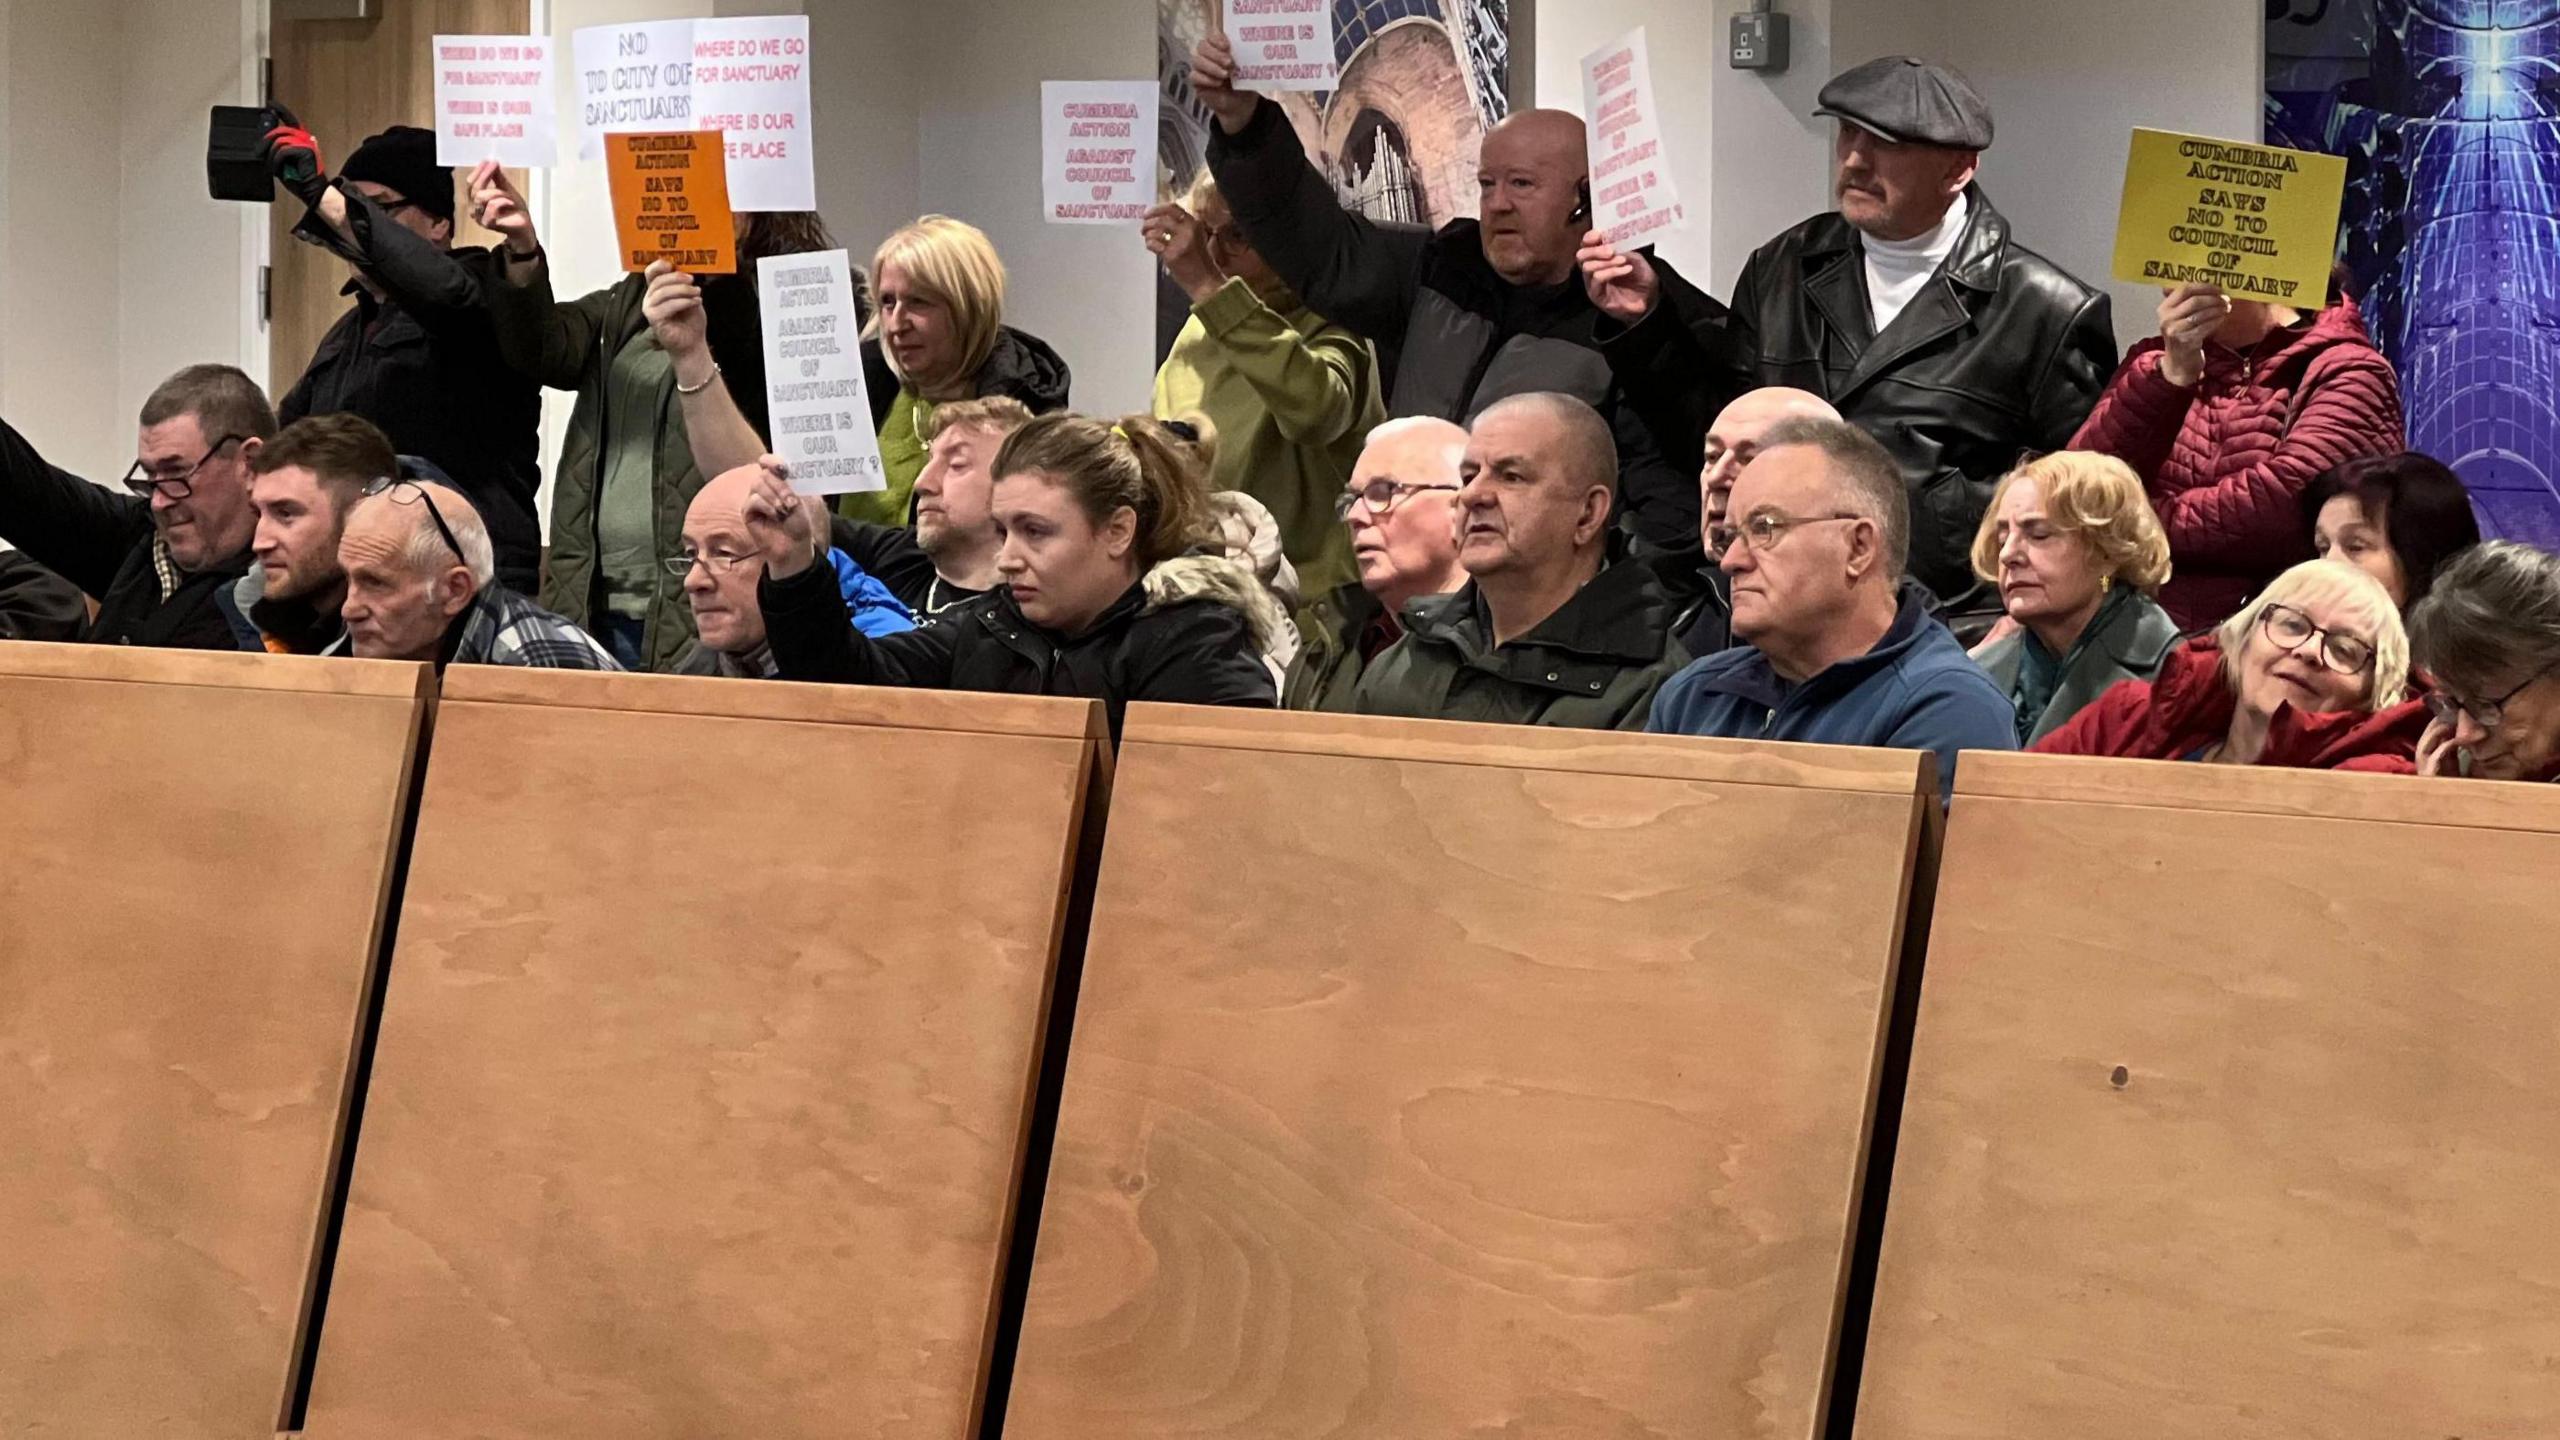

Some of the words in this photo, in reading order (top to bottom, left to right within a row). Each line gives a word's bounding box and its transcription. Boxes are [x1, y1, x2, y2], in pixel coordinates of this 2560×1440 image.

[1298, 24, 1314, 40] IS
[619, 32, 647, 56] NO
[695, 41, 735, 57] WHERE
[738, 40, 756, 56] DO
[760, 39, 780, 56] WE
[784, 38, 805, 55] GO
[1263, 44, 1298, 60] OUR
[585, 69, 607, 94] TO
[612, 64, 657, 91] CITY
[664, 62, 692, 86] OF
[696, 66, 718, 83] FOR
[722, 64, 800, 82] SANCTUARY
[1063, 103, 1138, 119] CUMBRIA
[701, 114, 743, 130] WHERE
[747, 113, 759, 130] IS
[763, 113, 794, 130] OUR
[1069, 122, 1131, 137] ACTION
[741, 141, 786, 158] PLACE
[1066, 148, 1136, 164] AGAINST
[2179, 140, 2298, 173] CUMBRIA
[635, 154, 690, 170] ACTION
[1065, 167, 1136, 182] COUNCIL
[2187, 161, 2283, 190] ACTION
[645, 177, 684, 192] SAYS
[1091, 186, 1112, 201] OF
[641, 197, 662, 212] NO
[667, 196, 689, 212] TO
[2200, 188, 2266, 212] SAYS
[636, 215, 700, 231] COUNCIL
[2187, 207, 2224, 228] NO
[2235, 214, 2268, 234] TO
[659, 233, 678, 249] OF
[2169, 225, 2278, 257] COUNCIL
[2208, 251, 2241, 270] OF
[2144, 260, 2298, 298] SANCTUARY
[780, 287, 829, 308] ACTION
[778, 315, 837, 337] AGAINST
[780, 337, 841, 358] COUNCIL
[800, 359, 819, 377] OF
[780, 413, 834, 434] WHERE
[836, 411, 853, 430] IS
[803, 435, 838, 455] OUR
[786, 457, 865, 479] ANCTUARY
